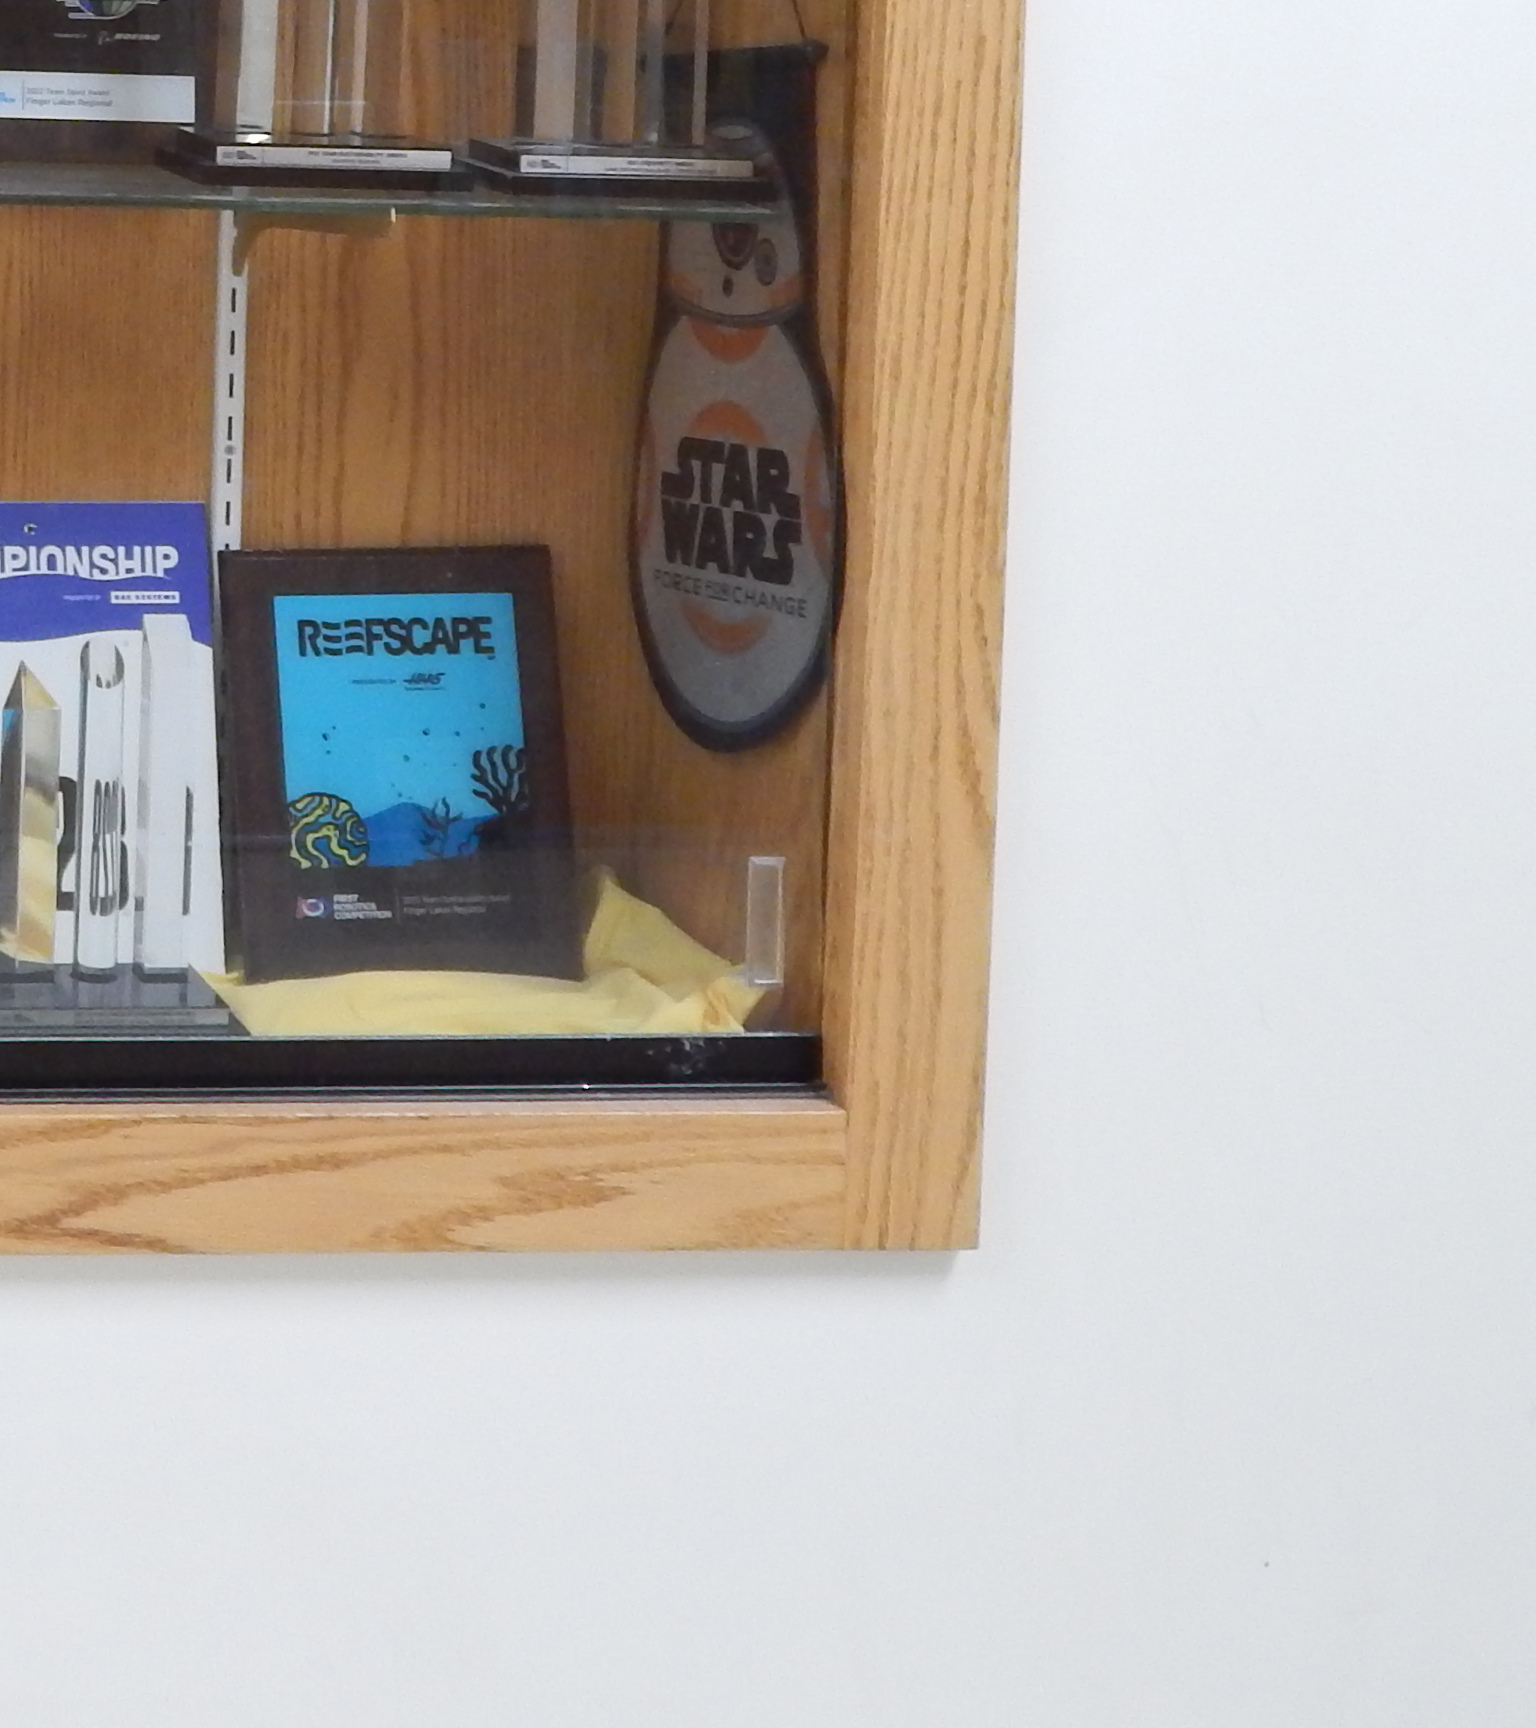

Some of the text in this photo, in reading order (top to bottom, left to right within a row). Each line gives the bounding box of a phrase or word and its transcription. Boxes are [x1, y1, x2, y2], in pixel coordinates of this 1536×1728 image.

[661, 436, 801, 521] STAR
[660, 494, 801, 586] WARS
[732, 585, 808, 619] CHANGE
[297, 615, 496, 658] REEFSCAPE
